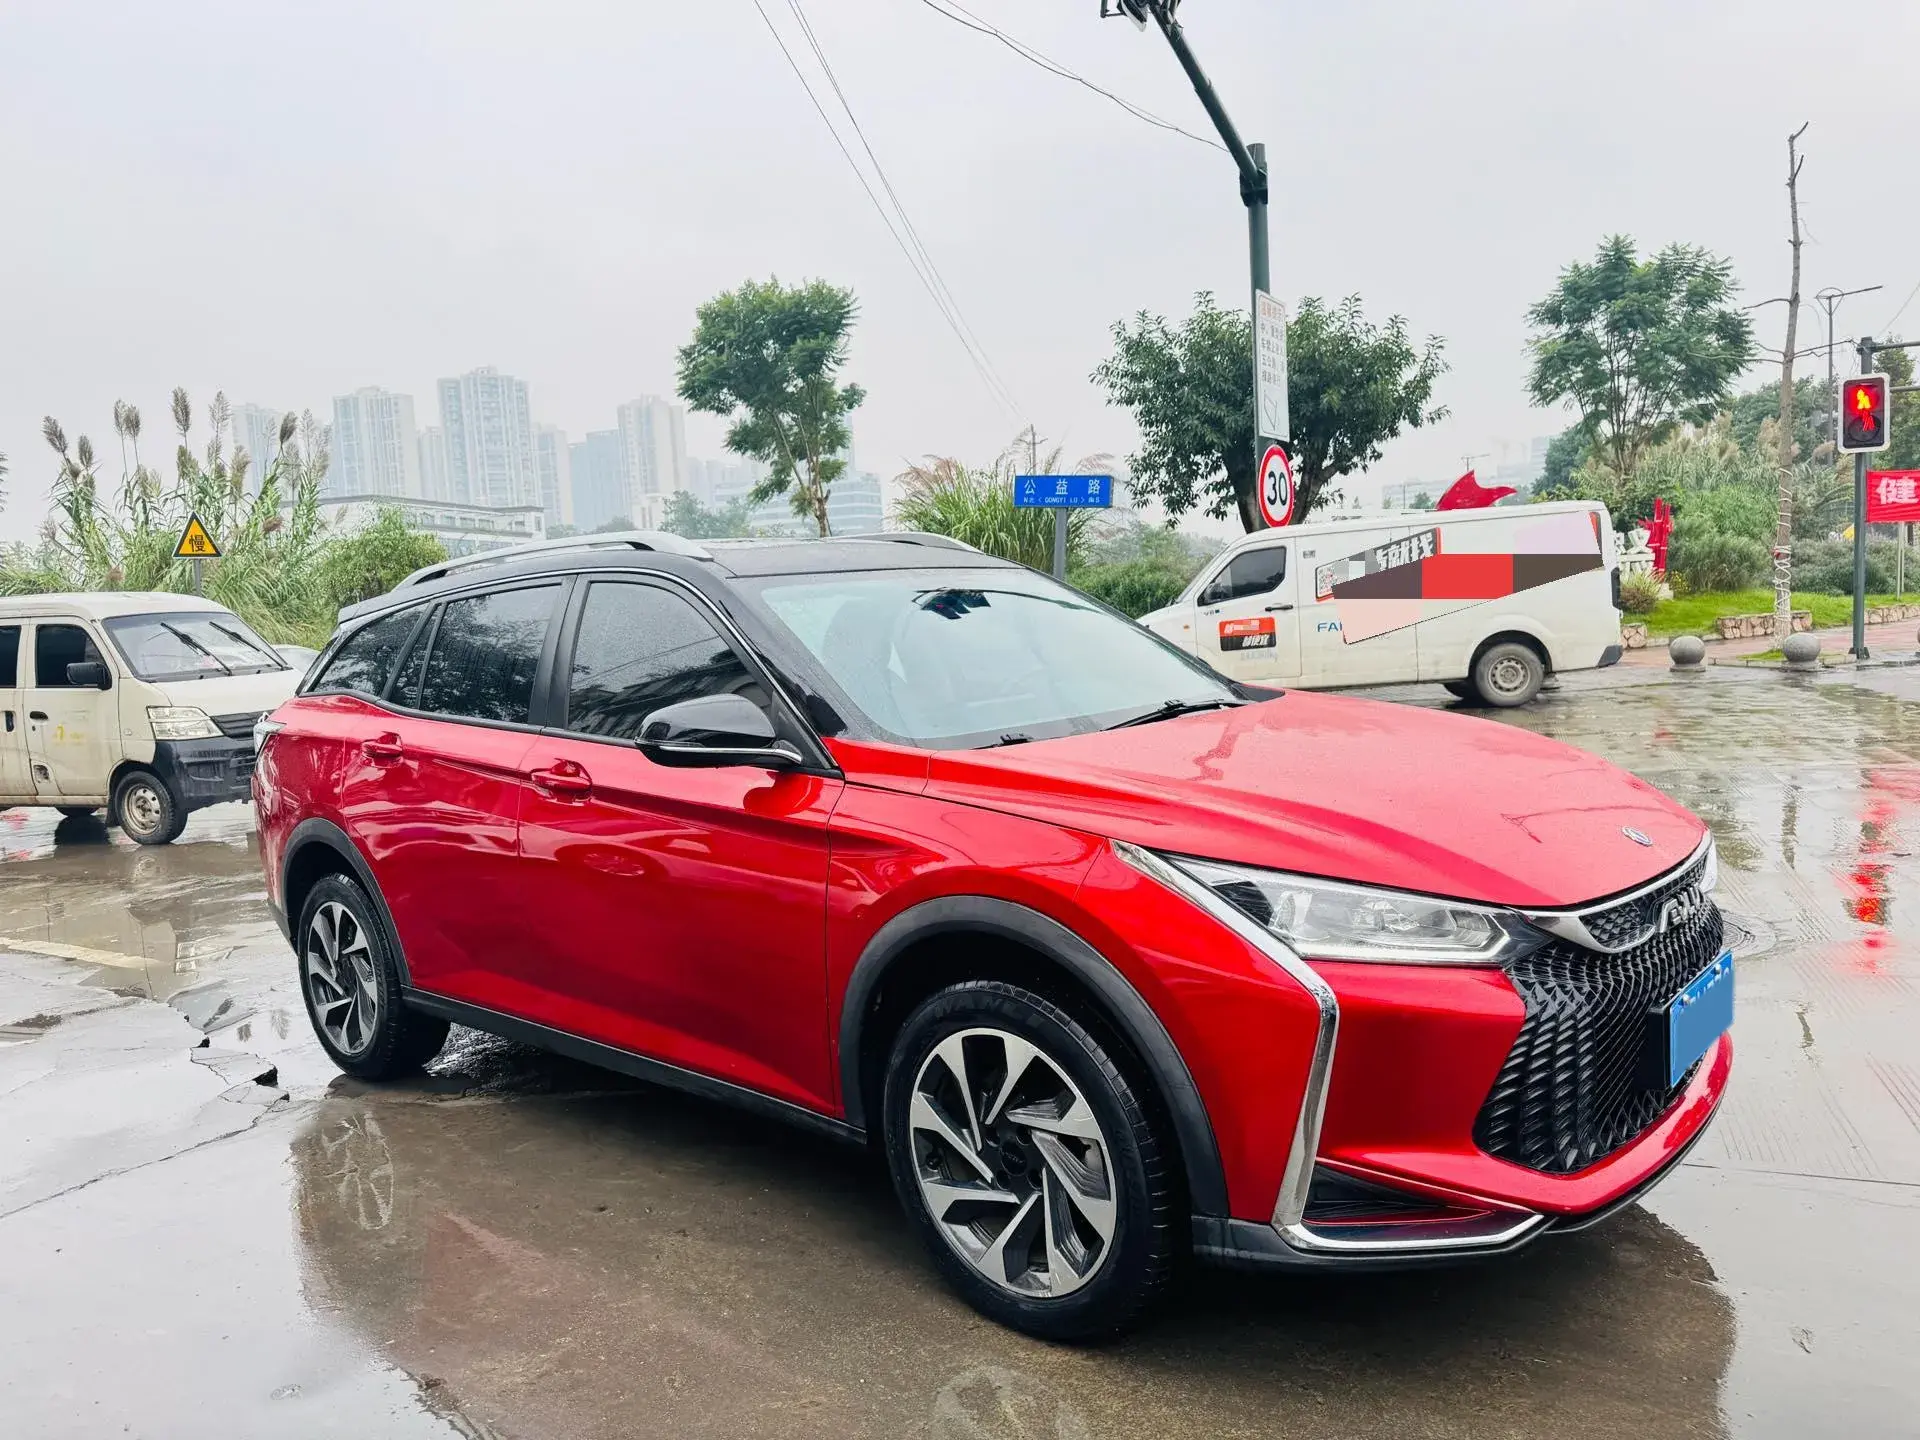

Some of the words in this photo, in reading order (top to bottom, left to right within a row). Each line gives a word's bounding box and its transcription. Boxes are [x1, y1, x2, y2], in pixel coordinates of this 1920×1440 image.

[1024, 478, 1101, 495] 公益路
[1266, 470, 1288, 506] 30
[1875, 476, 1919, 505] 健
[189, 534, 205, 552] 慢
